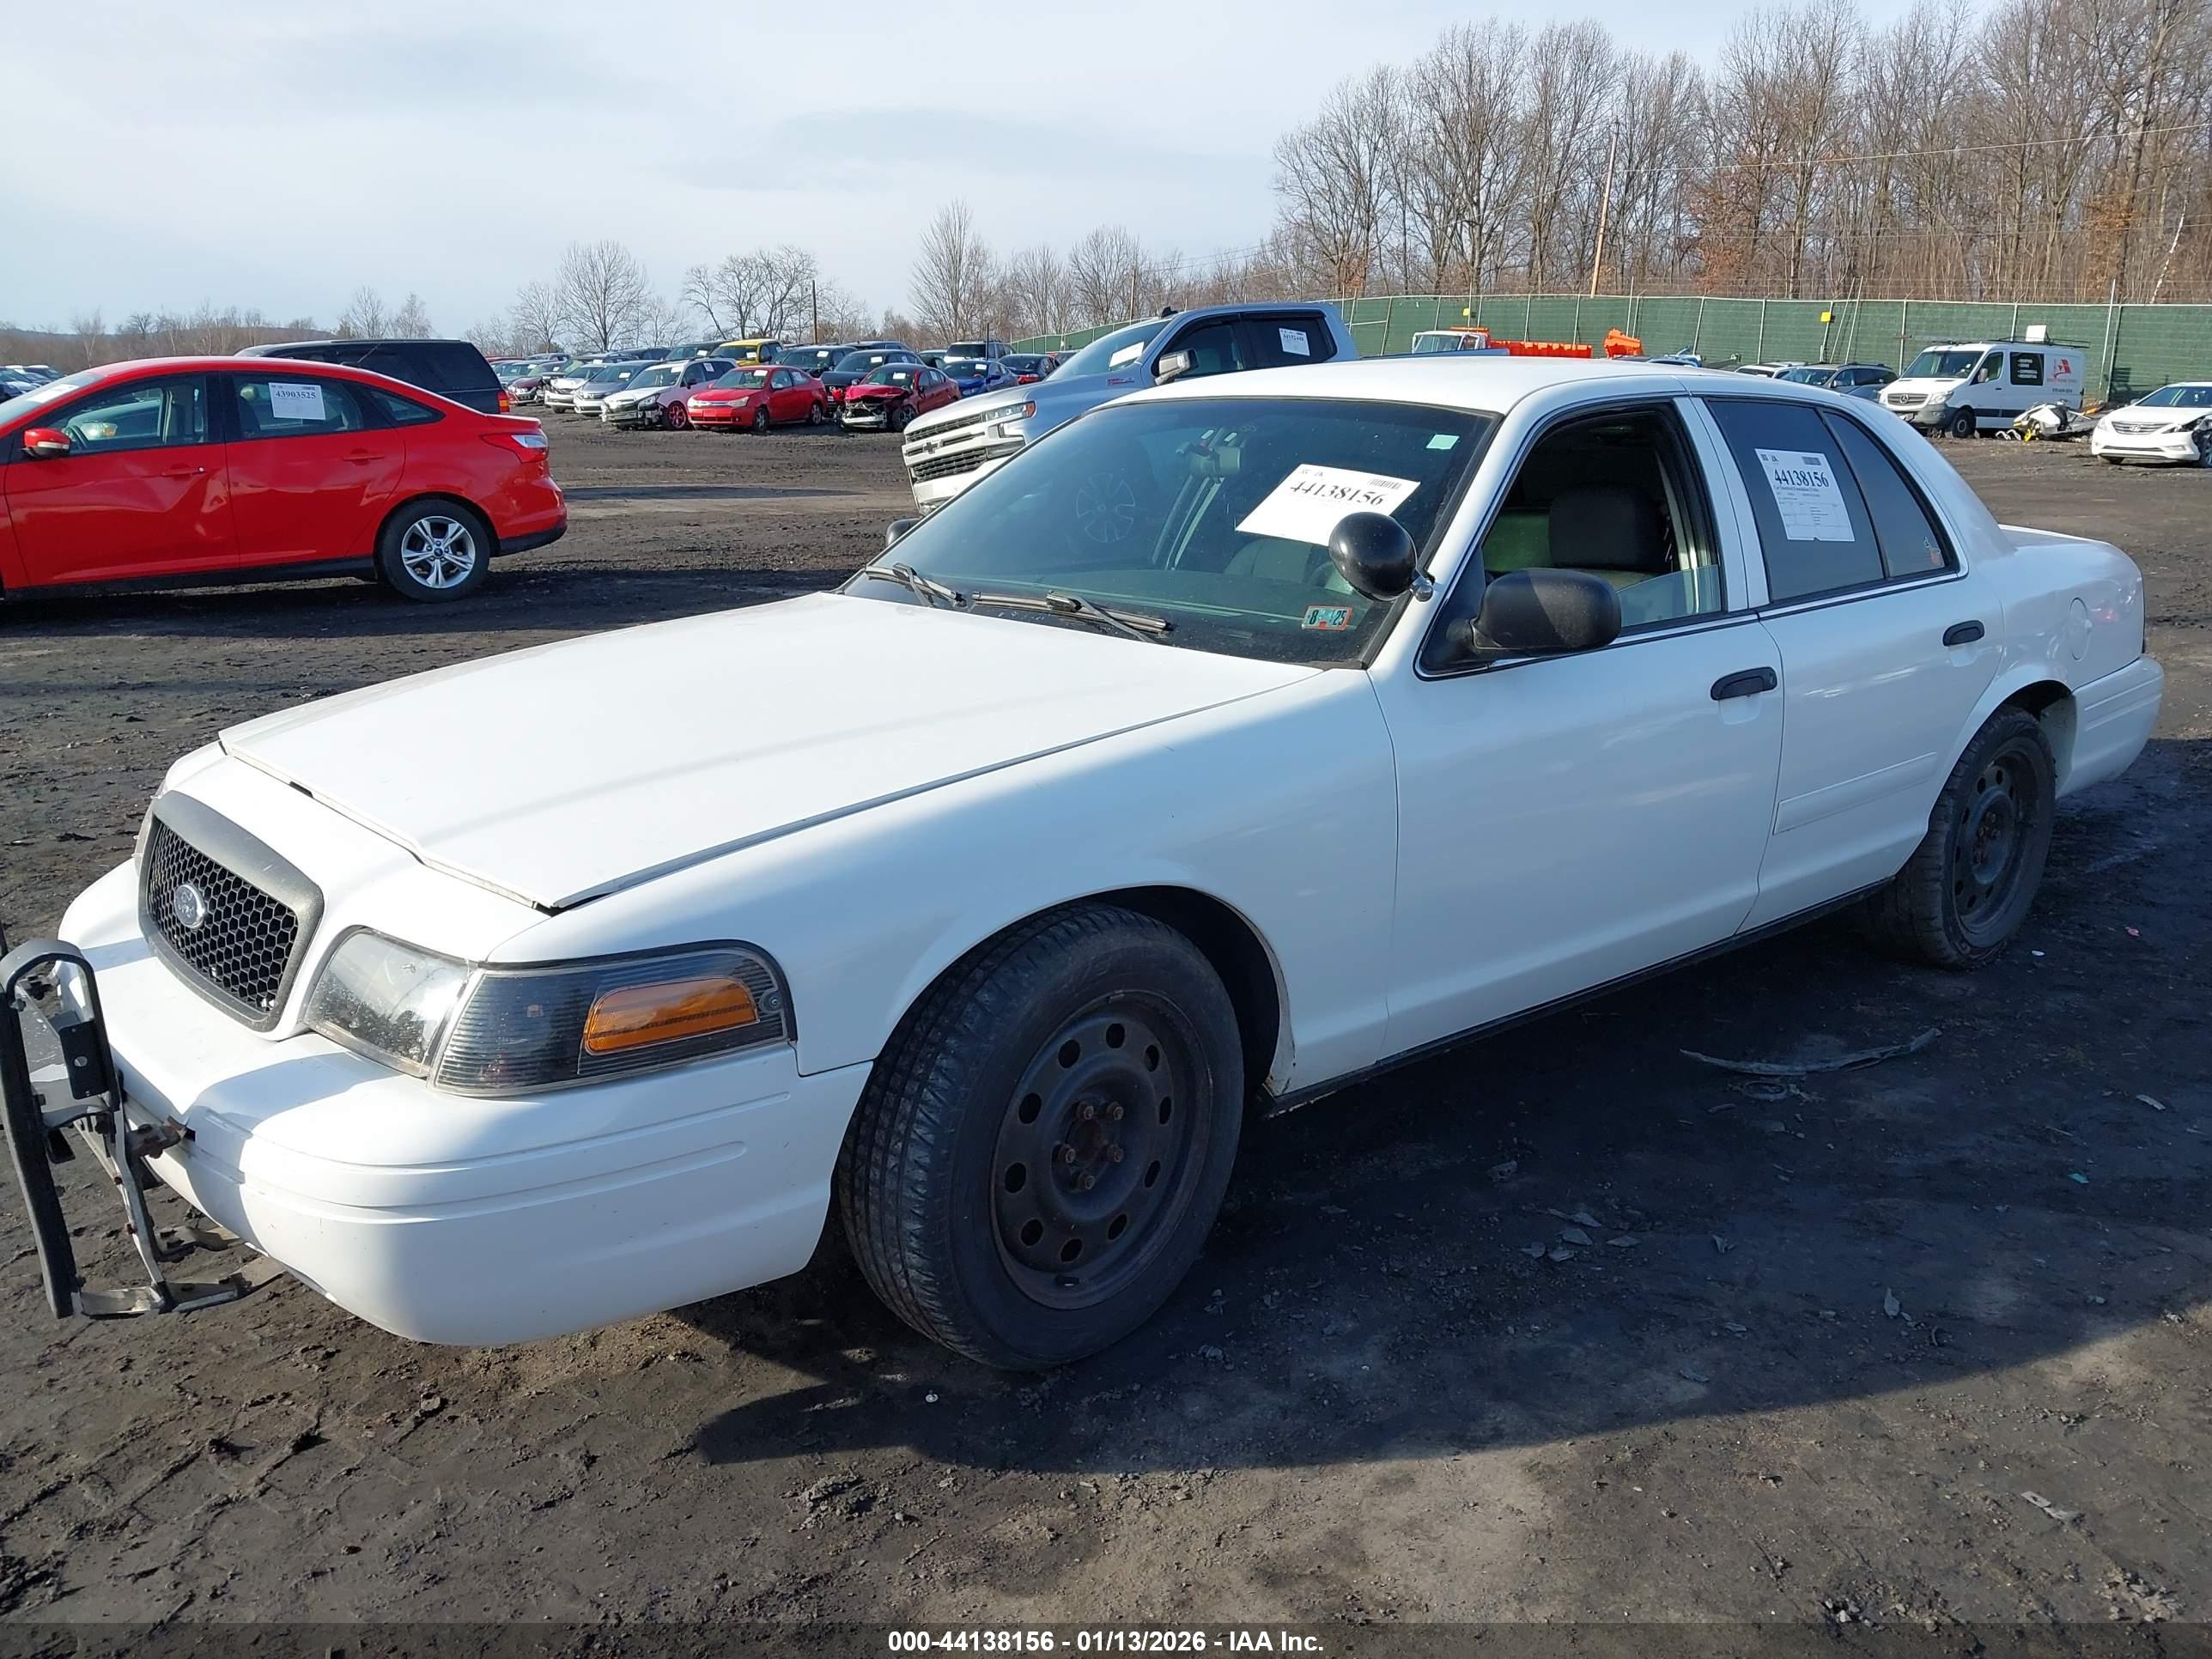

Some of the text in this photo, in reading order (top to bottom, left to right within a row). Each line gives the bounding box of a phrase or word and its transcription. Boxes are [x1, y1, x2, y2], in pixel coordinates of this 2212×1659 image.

[276, 391, 316, 399] 43903525
[1774, 468, 1829, 487] 44138156
[1290, 480, 1388, 506] 44138156
[1309, 609, 1347, 626] 8 25
